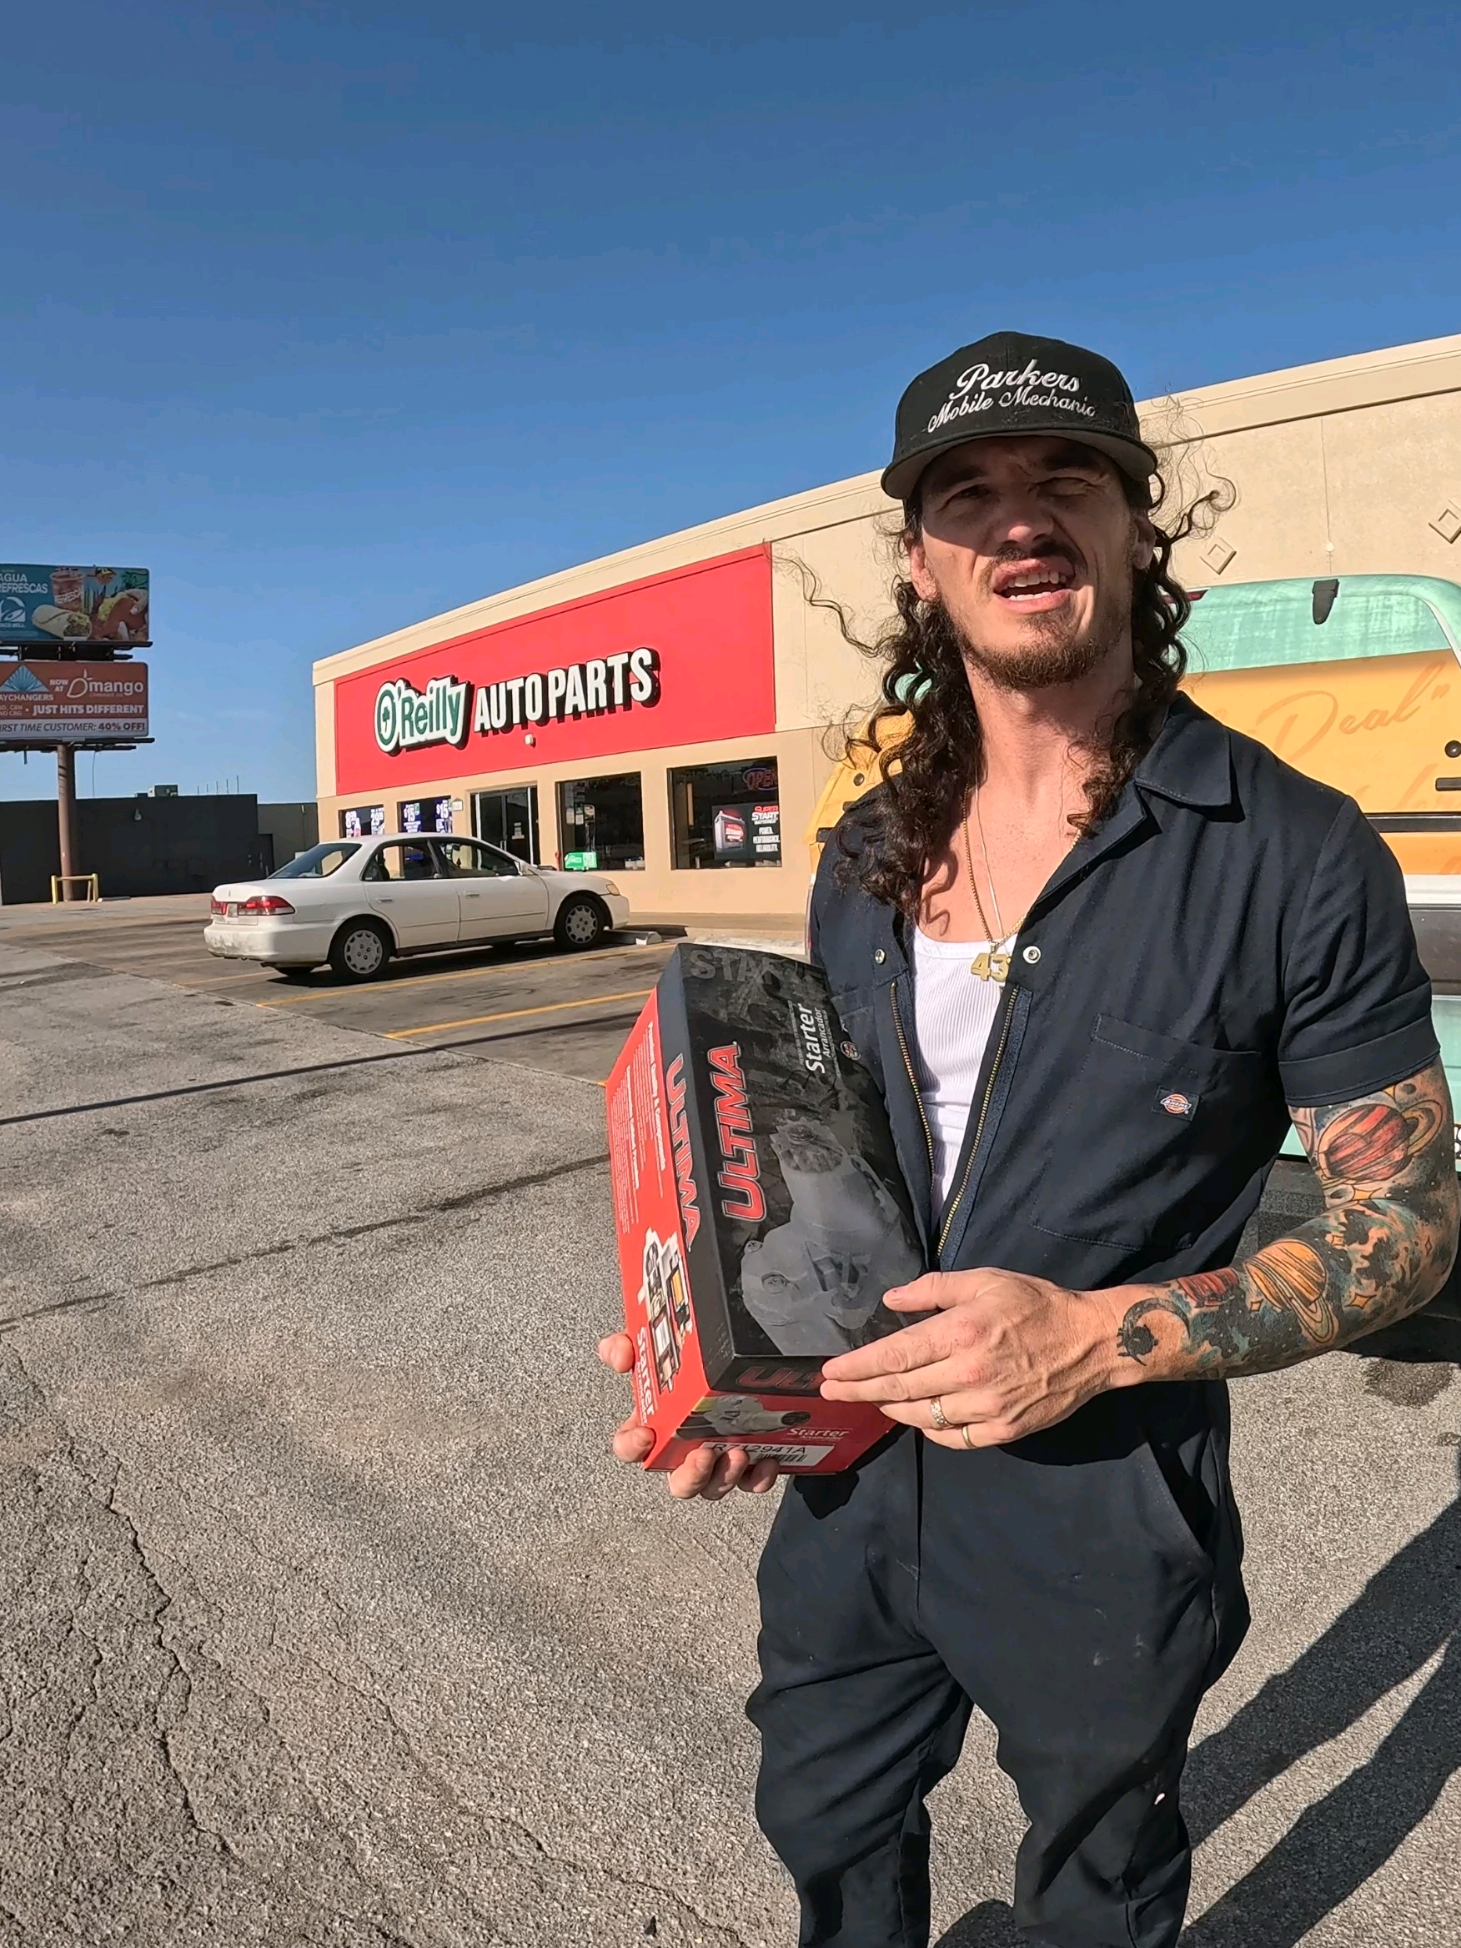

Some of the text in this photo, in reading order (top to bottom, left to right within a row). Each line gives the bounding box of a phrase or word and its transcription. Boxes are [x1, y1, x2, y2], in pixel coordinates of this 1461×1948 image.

[949, 359, 1080, 399] Parkers
[927, 386, 1097, 433] Mobile Mechanic
[0, 573, 28, 583] AGUA
[32, 705, 144, 716] JUST HITS DIFFERENT
[375, 648, 653, 749] O'Reilly AUTO PARTS
[0, 722, 146, 732] IRST TIME CUSTOMER: 40% OFF!
[751, 811, 779, 821] START
[798, 1003, 825, 1074] Starter
[814, 1007, 832, 1058] Arrancador
[665, 1052, 701, 1252] ULTIMA
[707, 1041, 767, 1221] ULTIMA
[637, 1326, 655, 1416] Starter
[787, 1427, 850, 1437] Starter
